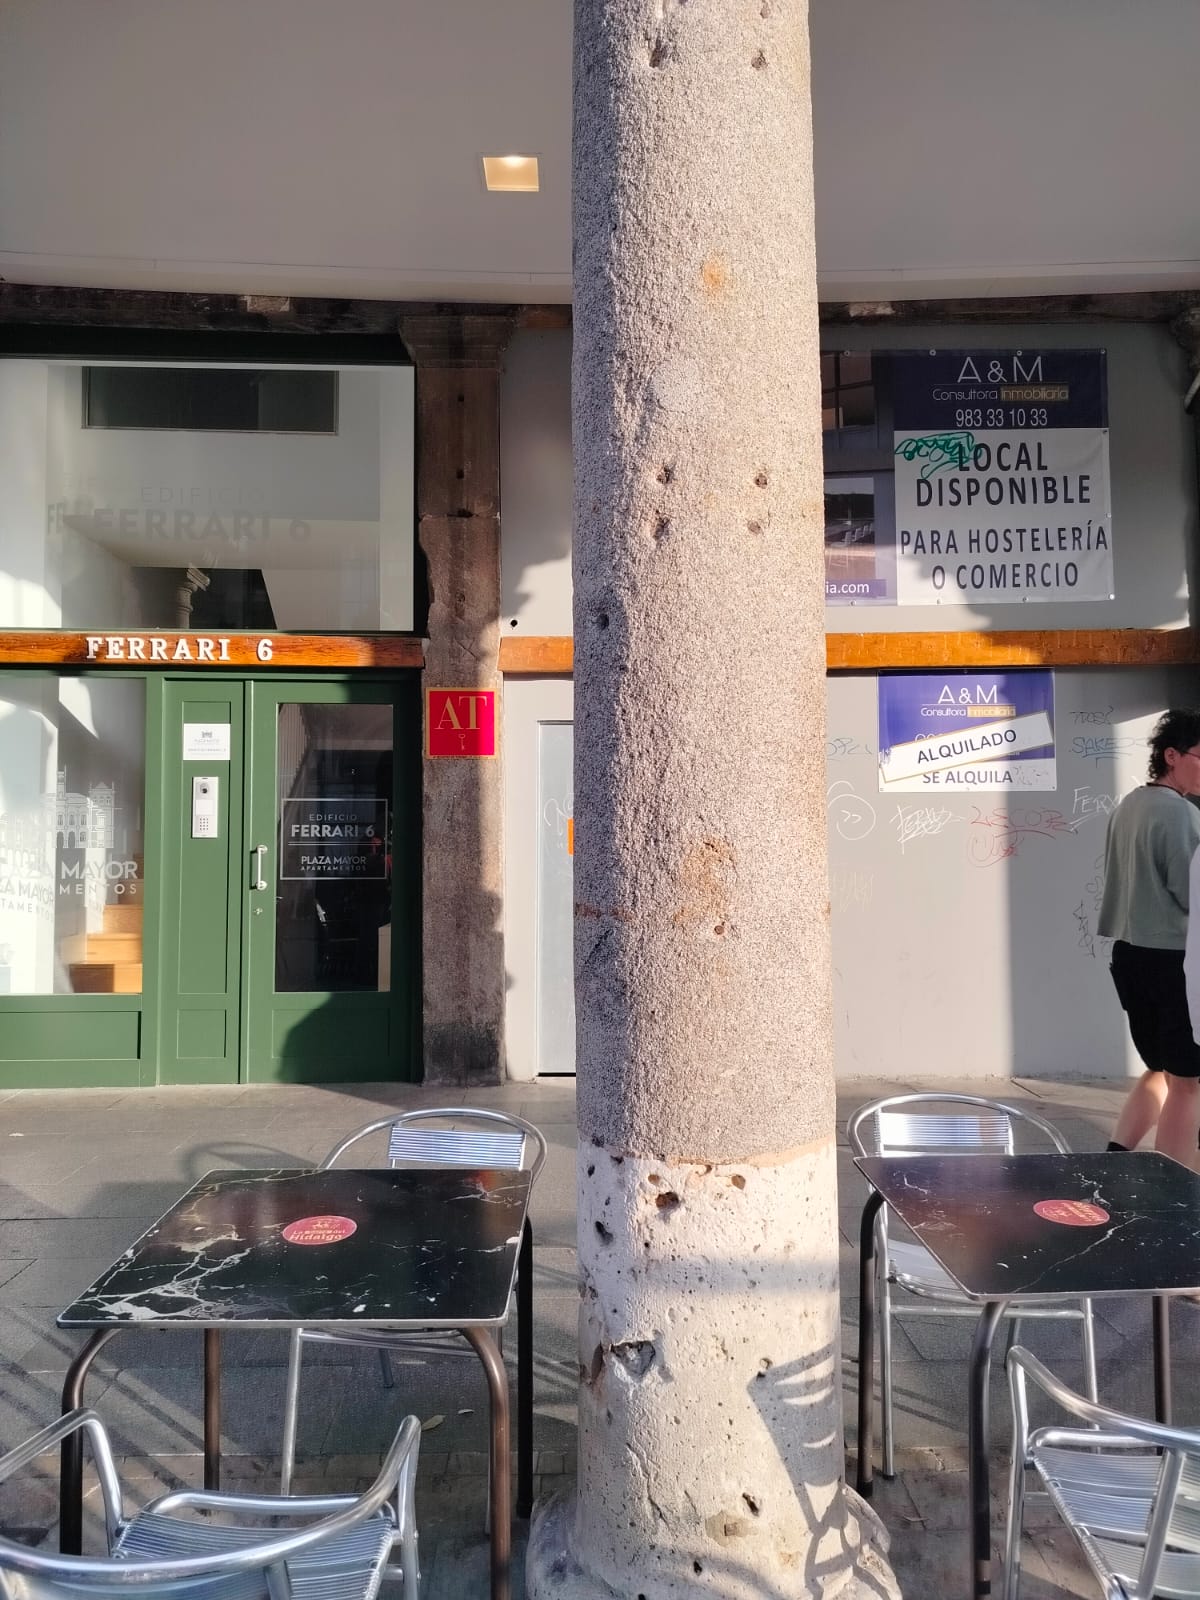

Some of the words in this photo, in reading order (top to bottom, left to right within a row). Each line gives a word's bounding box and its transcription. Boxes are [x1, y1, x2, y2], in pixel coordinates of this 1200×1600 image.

[932, 388, 998, 401] Consultora
[956, 408, 982, 427] 983
[986, 408, 1004, 427] 33
[1009, 408, 1026, 426] 10
[1030, 408, 1048, 426] 33
[957, 441, 1049, 473] LOCAL
[916, 475, 1092, 507] DISPONIBLE
[901, 530, 959, 555] PARA
[968, 519, 1109, 555] HOSTELERÍA
[932, 565, 946, 590] O
[956, 562, 1079, 589] COMERCIO
[86, 637, 230, 662] FERRARI
[257, 639, 273, 661] 6
[433, 696, 488, 730] AT
[921, 707, 966, 718] Consultora
[917, 729, 1017, 765] ALQUILADO
[923, 772, 940, 784] SE
[945, 771, 1014, 786] ALQUILA
[309, 813, 358, 821] EDIFICIO
[291, 824, 359, 838] FERRARI
[365, 825, 375, 838] 6
[61, 860, 138, 880] MAYOR
[301, 856, 332, 865] PLAZA
[333, 856, 367, 865] MAYOR
